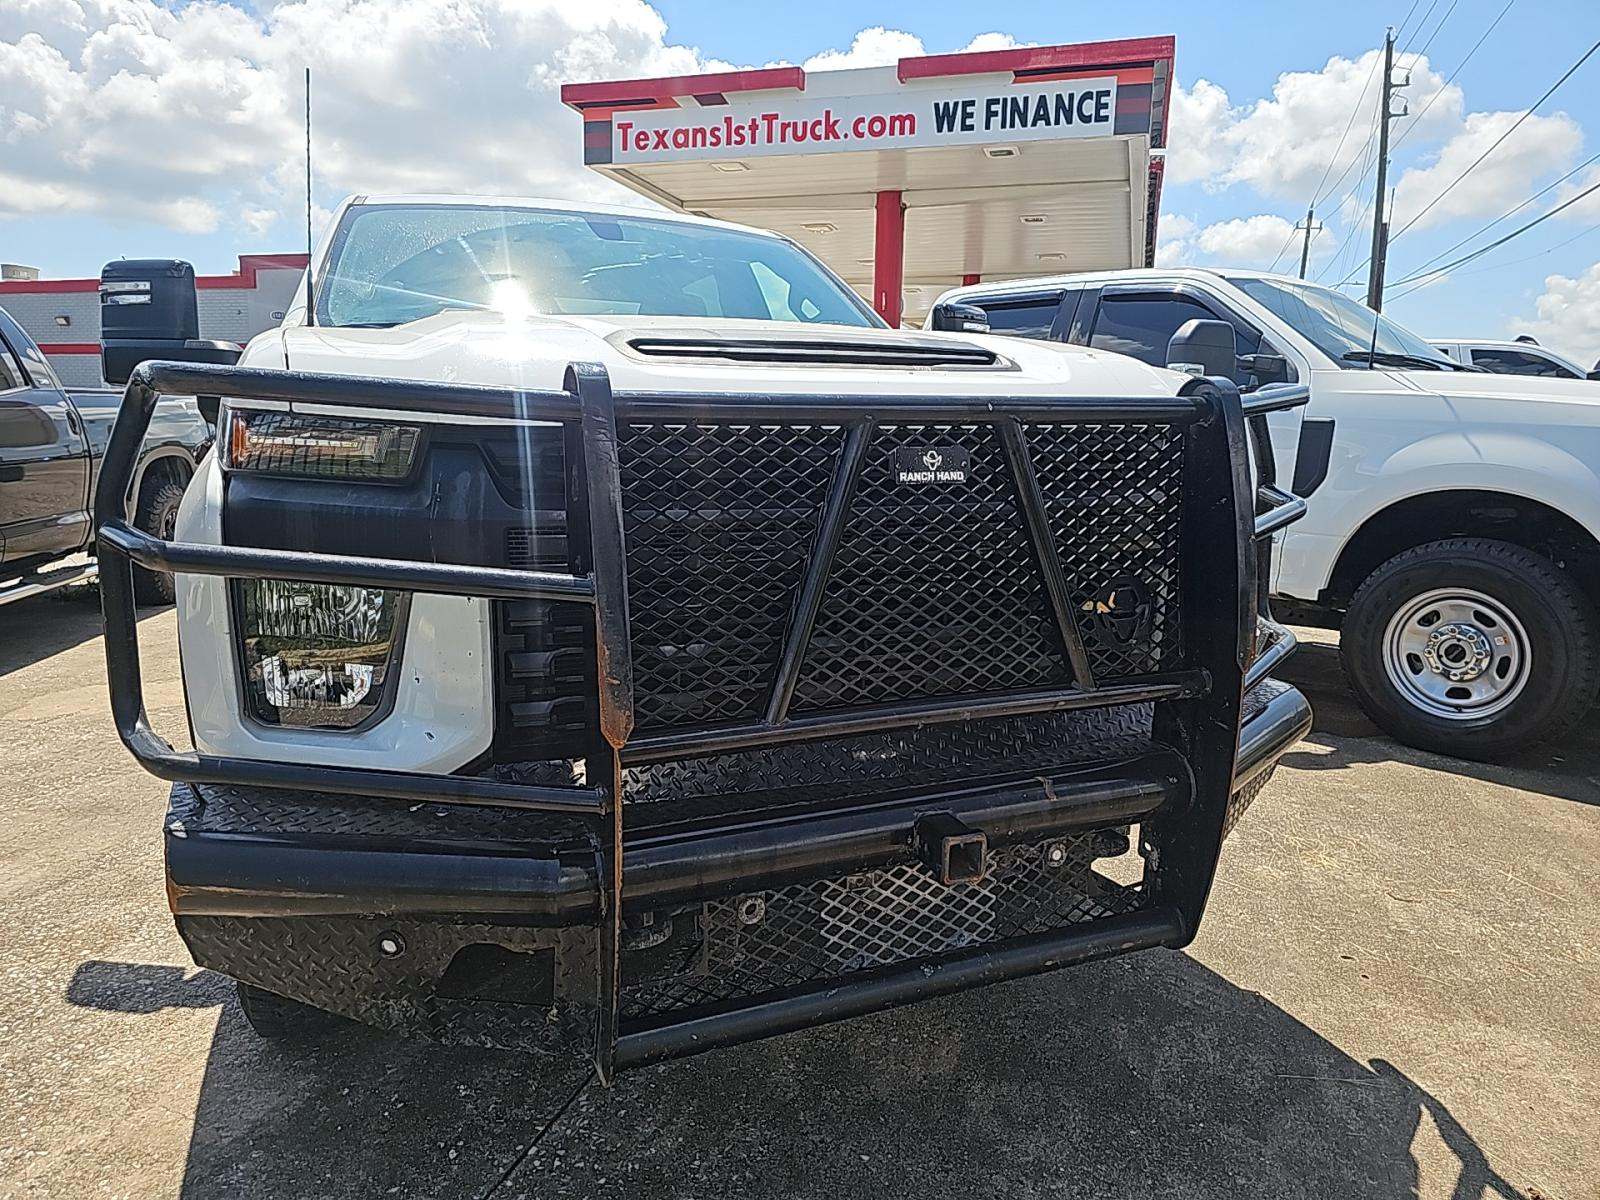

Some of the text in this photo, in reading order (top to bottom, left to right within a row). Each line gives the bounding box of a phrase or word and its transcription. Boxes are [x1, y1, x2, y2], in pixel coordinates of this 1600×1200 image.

[616, 89, 1111, 152] Texans1stTruck.com WE FINANCE
[899, 470, 964, 482] RANCH HAND
